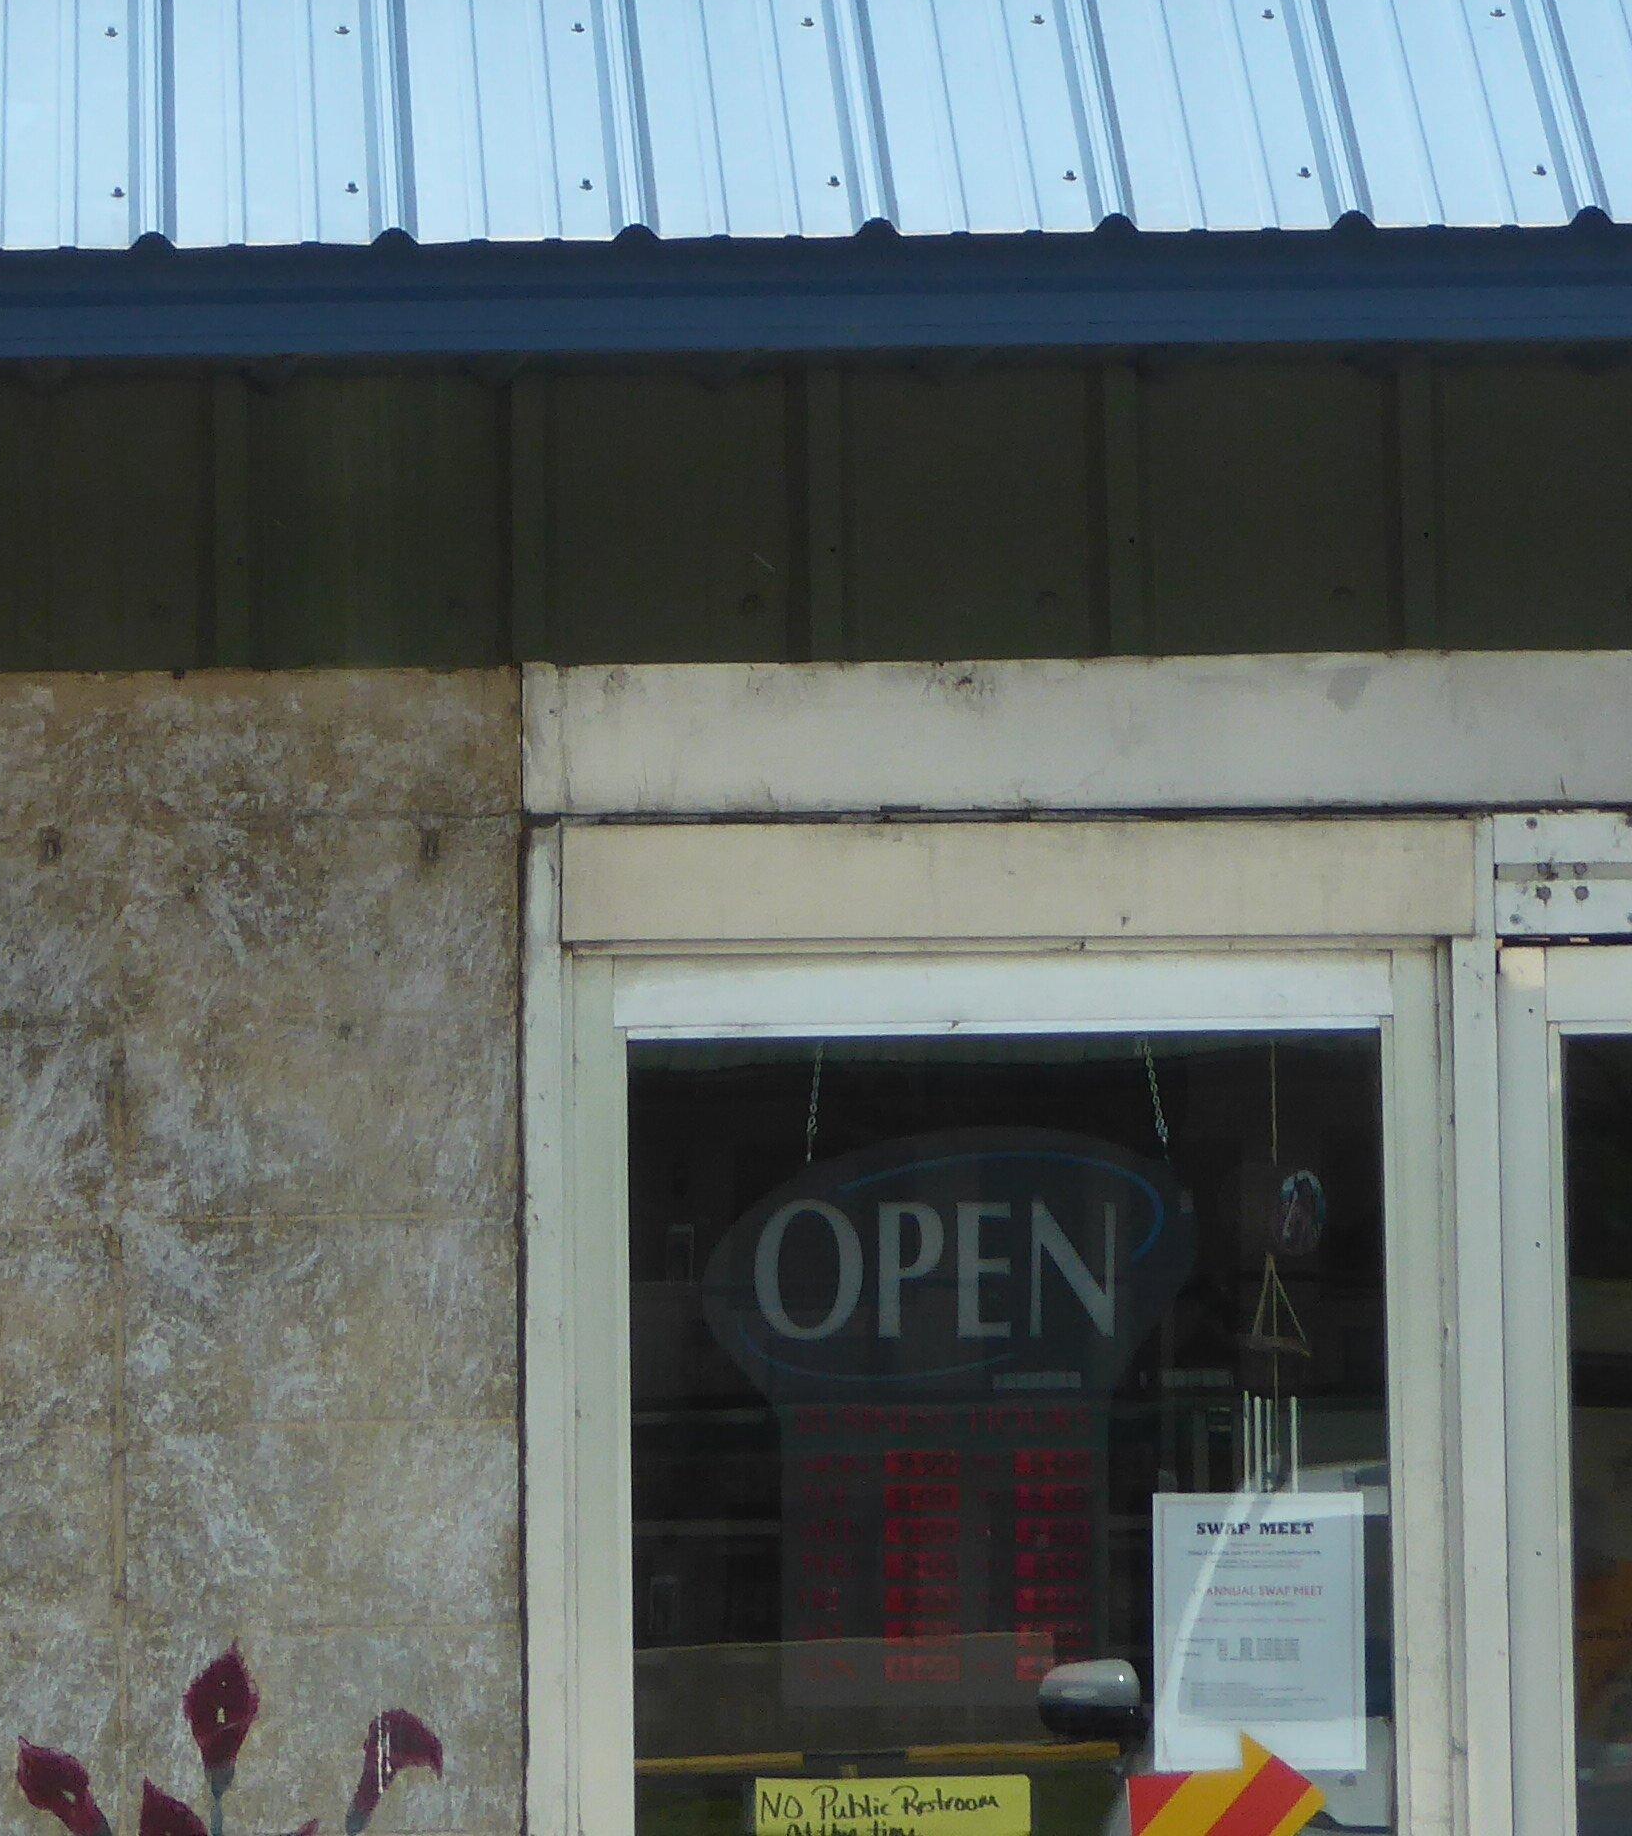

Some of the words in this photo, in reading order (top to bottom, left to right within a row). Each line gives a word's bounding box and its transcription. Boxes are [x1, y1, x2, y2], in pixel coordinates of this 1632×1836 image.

[753, 1197, 1117, 1340] OPEN
[1196, 1521, 1251, 1535] SWAP
[1258, 1521, 1315, 1535] MEET
[1293, 1585, 1324, 1597] MEET
[811, 1784, 892, 1821] Public
[889, 1784, 1001, 1817] Restroom
